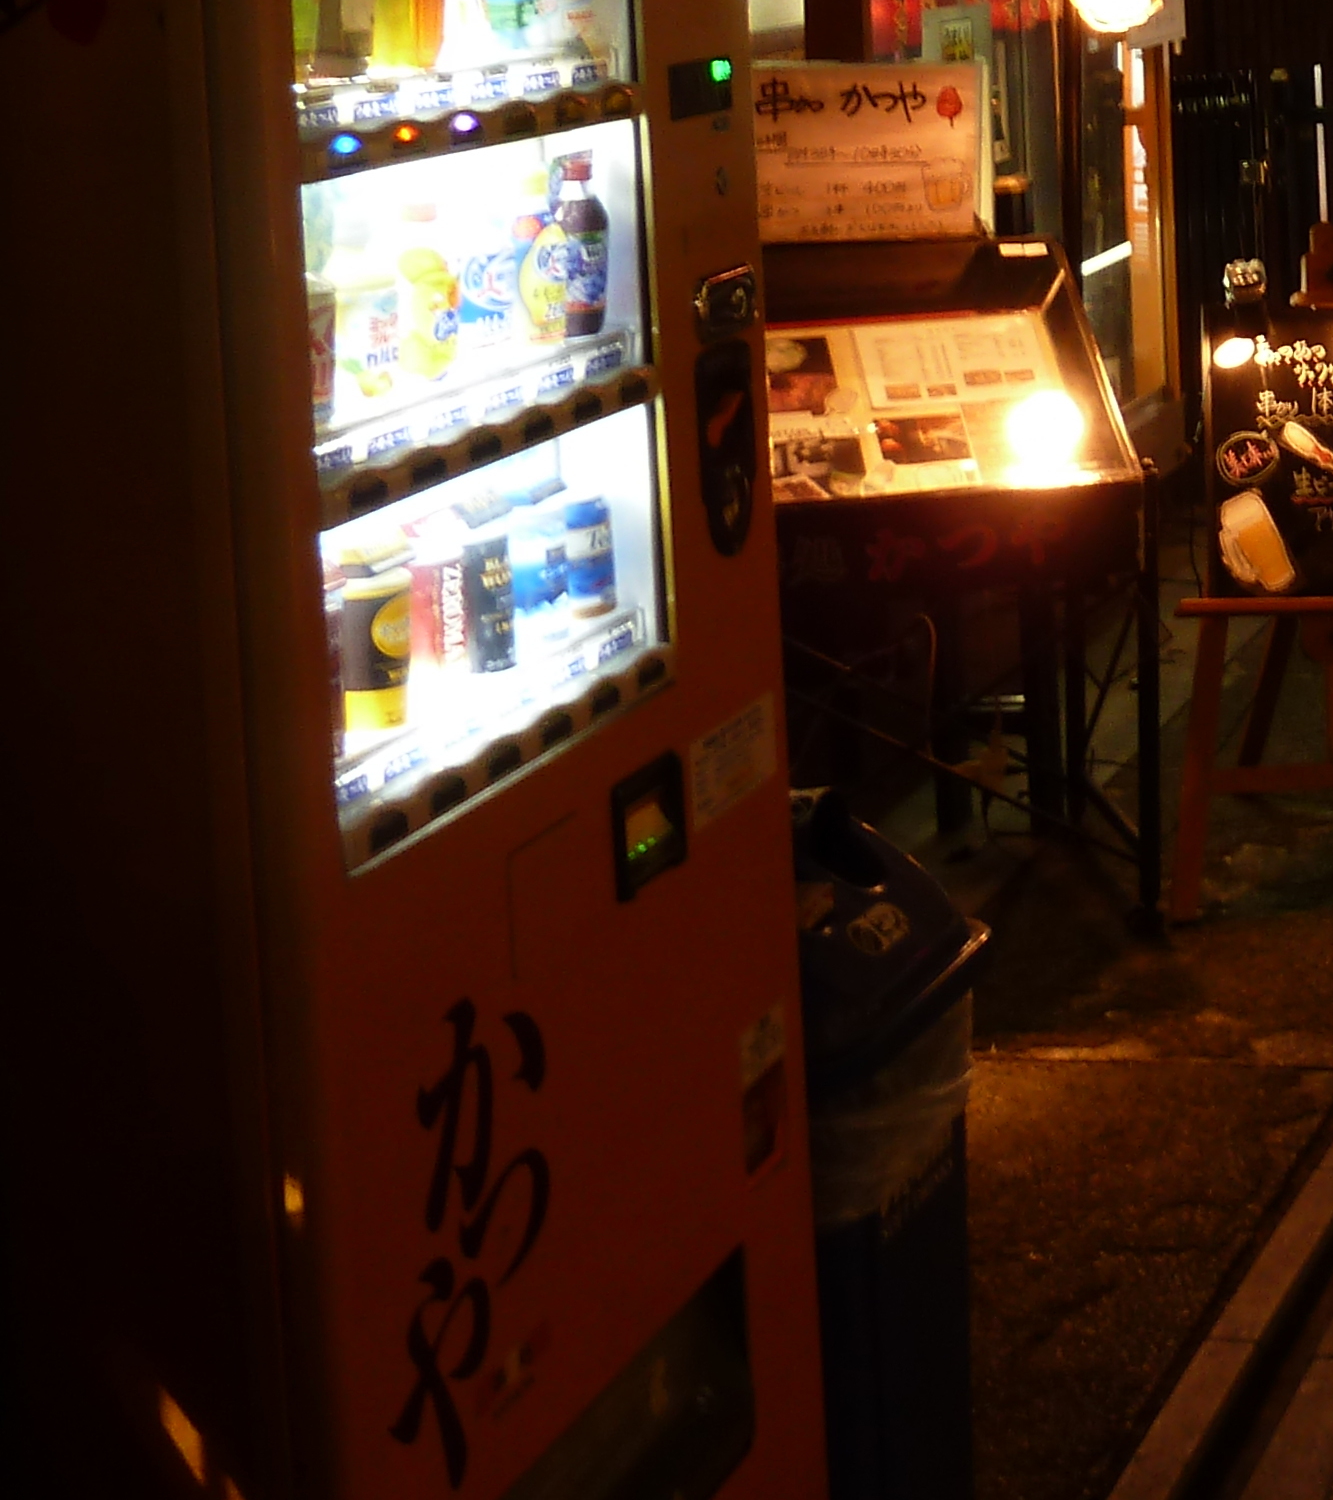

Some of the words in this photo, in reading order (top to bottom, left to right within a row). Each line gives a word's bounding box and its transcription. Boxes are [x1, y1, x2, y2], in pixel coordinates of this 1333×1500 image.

[839, 80, 928, 124] かつや
[389, 995, 552, 1491] かつや
